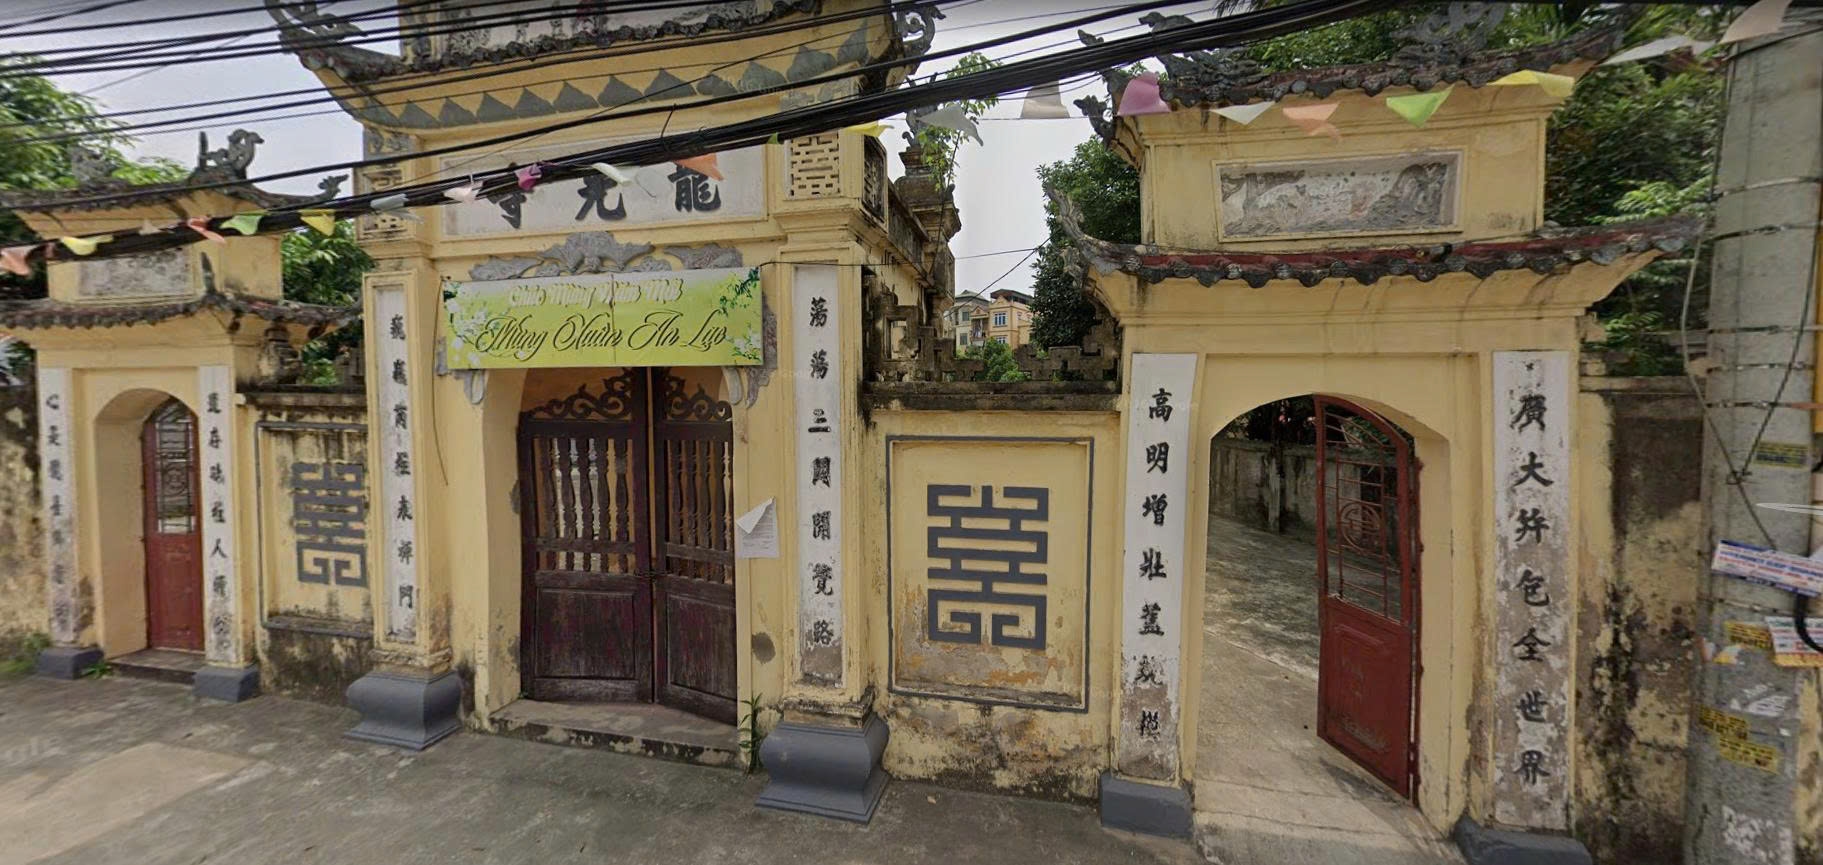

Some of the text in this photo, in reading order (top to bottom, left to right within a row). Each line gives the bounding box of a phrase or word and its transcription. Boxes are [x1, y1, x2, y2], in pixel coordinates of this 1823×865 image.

[475, 314, 548, 362] Mừng
[553, 312, 623, 351] Xuân
[628, 308, 683, 350] An
